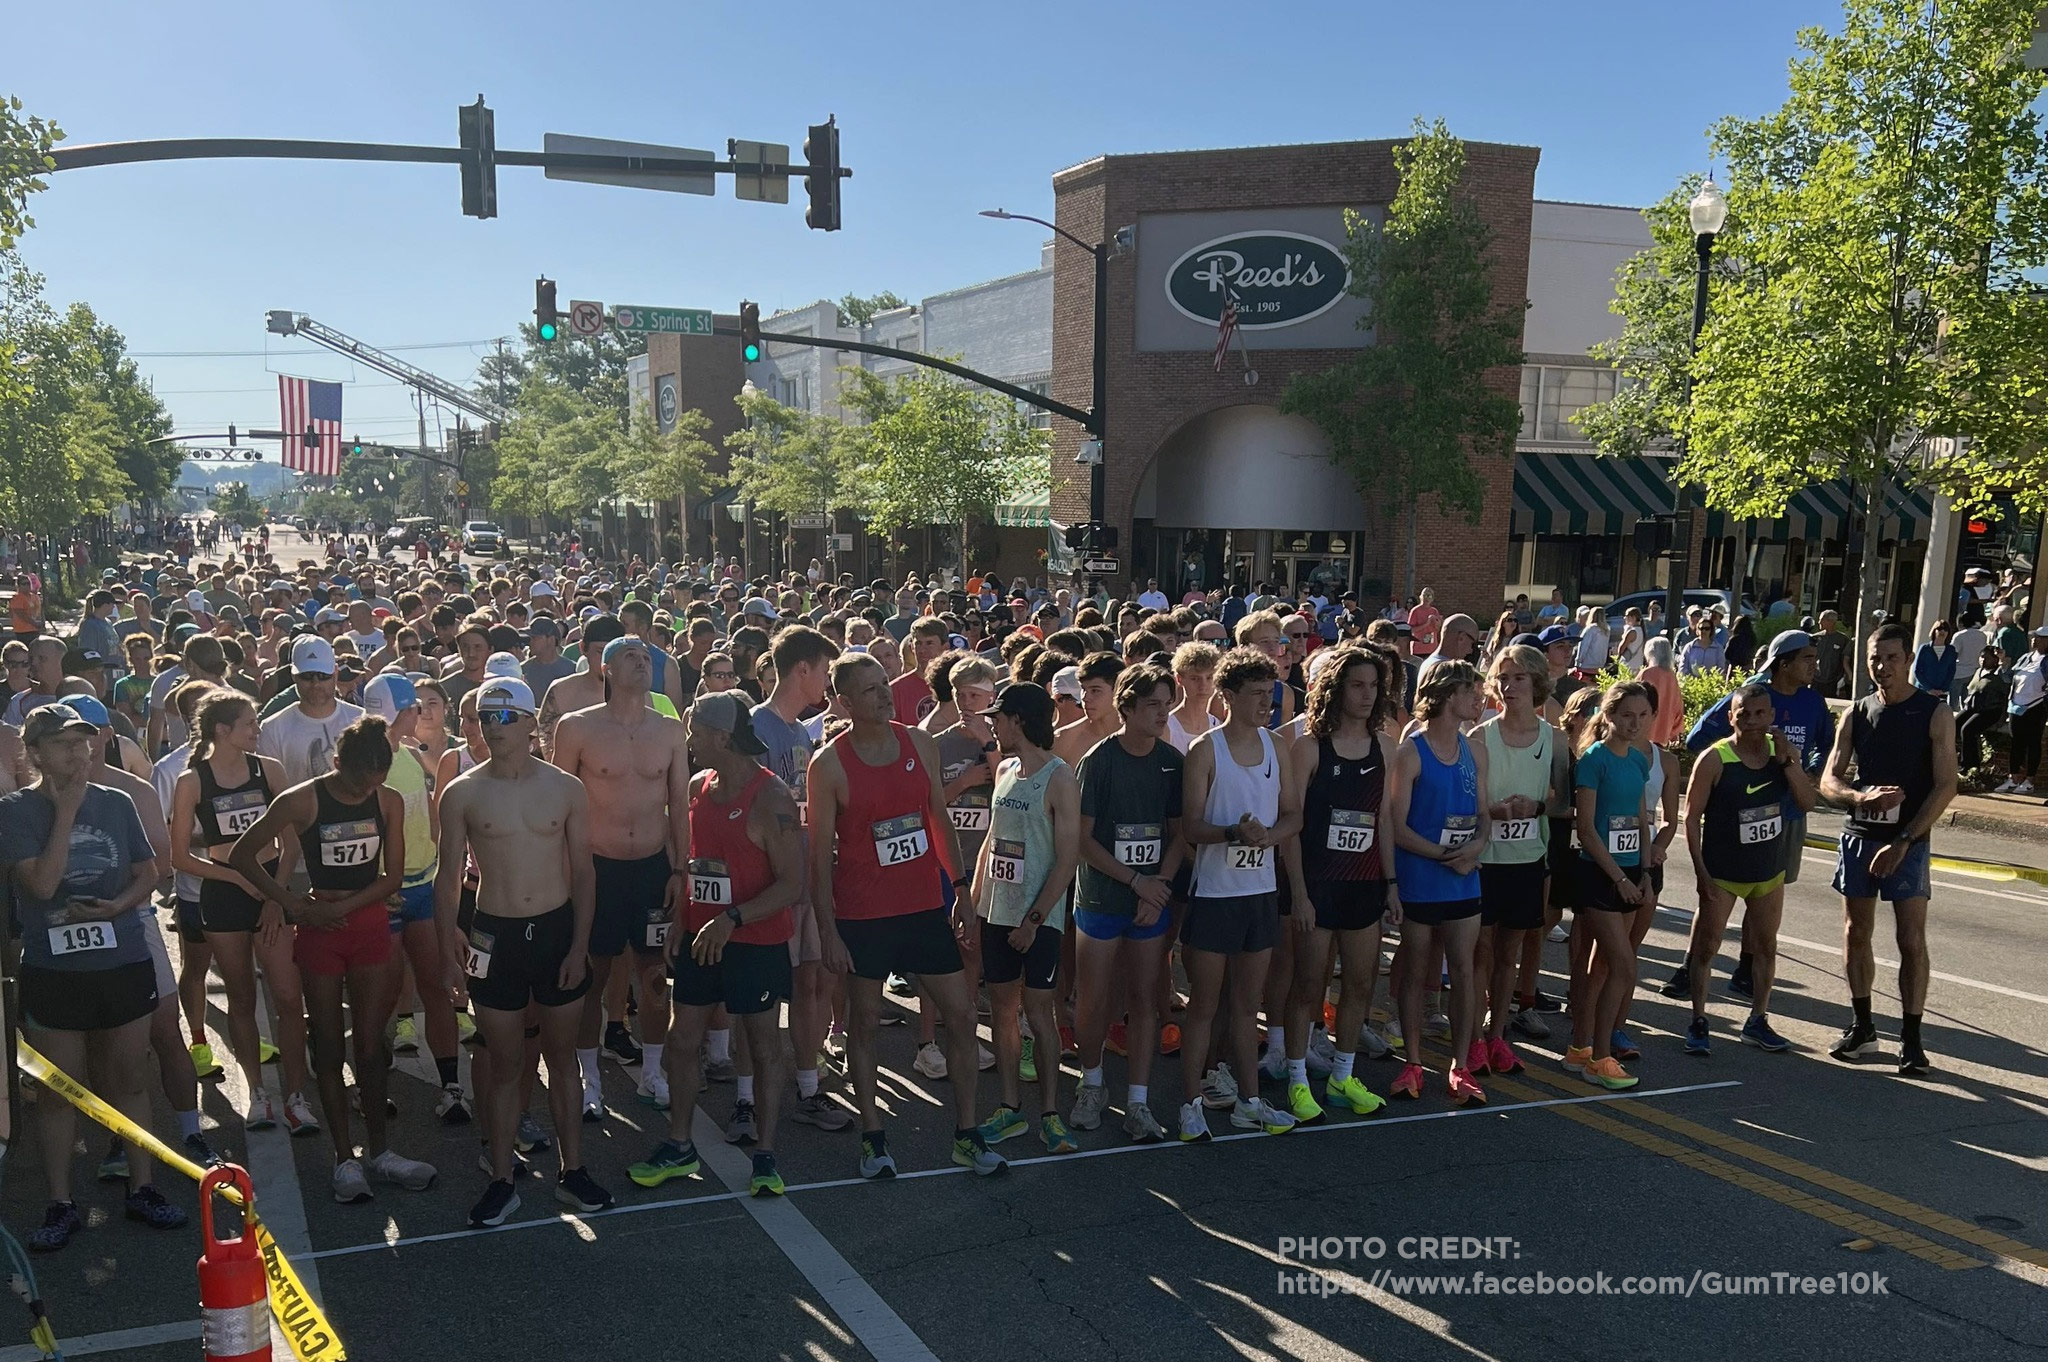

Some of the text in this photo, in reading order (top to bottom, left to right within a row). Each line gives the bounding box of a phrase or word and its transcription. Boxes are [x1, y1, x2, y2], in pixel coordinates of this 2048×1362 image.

[1193, 250, 1325, 299] Reed's
[1233, 302, 1281, 313] Est. 1905
[635, 311, 644, 328] S
[650, 312, 690, 334] Spring
[696, 314, 710, 332] St
[1784, 725, 1806, 735] JUDE
[1785, 734, 1806, 743] PHIS
[995, 796, 1030, 812] BOSTON
[229, 811, 259, 832] 457
[953, 811, 981, 828] 527
[1337, 830, 1368, 850] 567
[1500, 822, 1530, 840] 327
[1749, 821, 1776, 841] 364
[887, 836, 921, 863] 251
[1617, 833, 1637, 851] 622
[334, 842, 369, 864] 571
[1125, 844, 1155, 863] 192
[1235, 849, 1265, 868] 242
[694, 879, 721, 902] 570
[63, 926, 105, 951] 193
